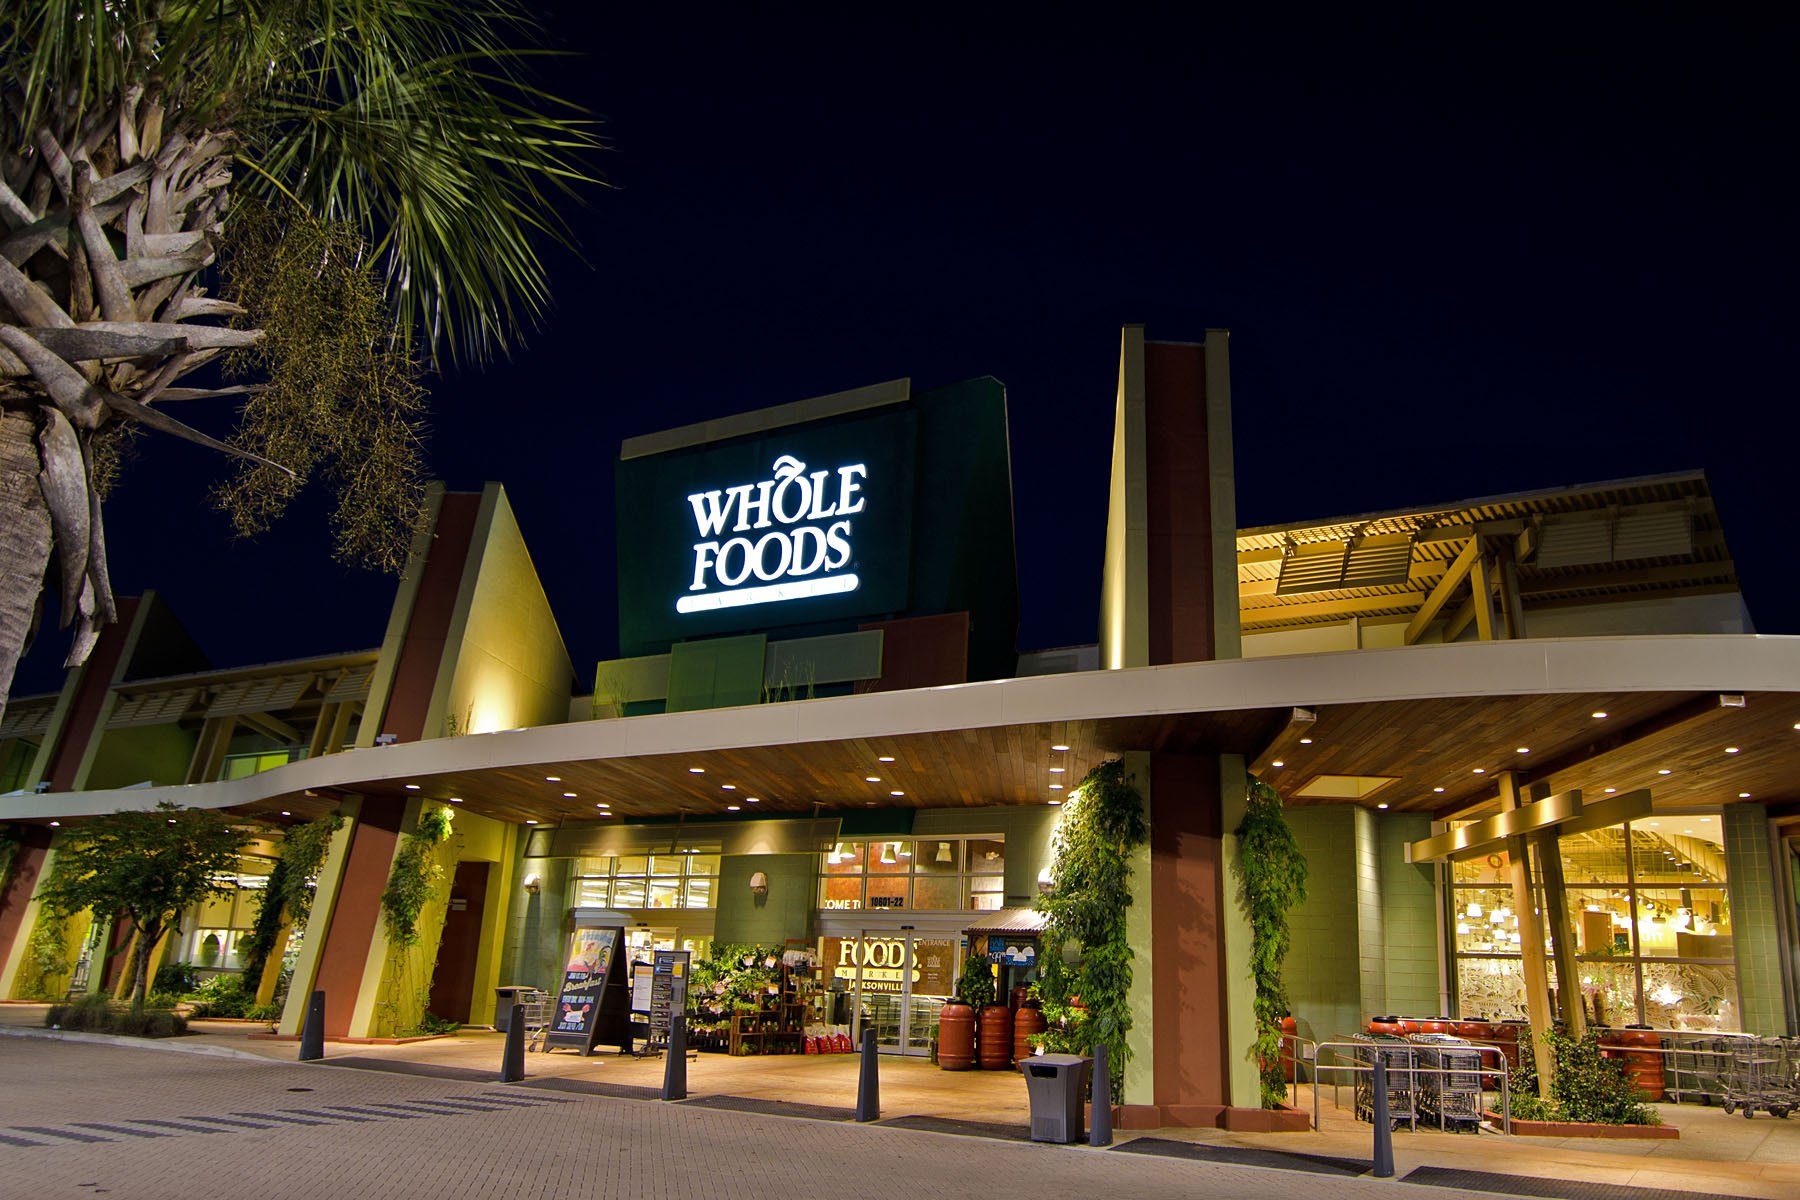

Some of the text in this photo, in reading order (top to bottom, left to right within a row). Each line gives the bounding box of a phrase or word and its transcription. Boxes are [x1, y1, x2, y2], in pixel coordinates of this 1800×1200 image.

[688, 456, 866, 537] WHOLE
[689, 520, 851, 590] FOODS
[871, 896, 904, 907] 10601-22
[918, 939, 951, 947] ENTRANCE
[563, 976, 602, 993] Breakfast
[848, 978, 903, 991] JAKSONVILL
